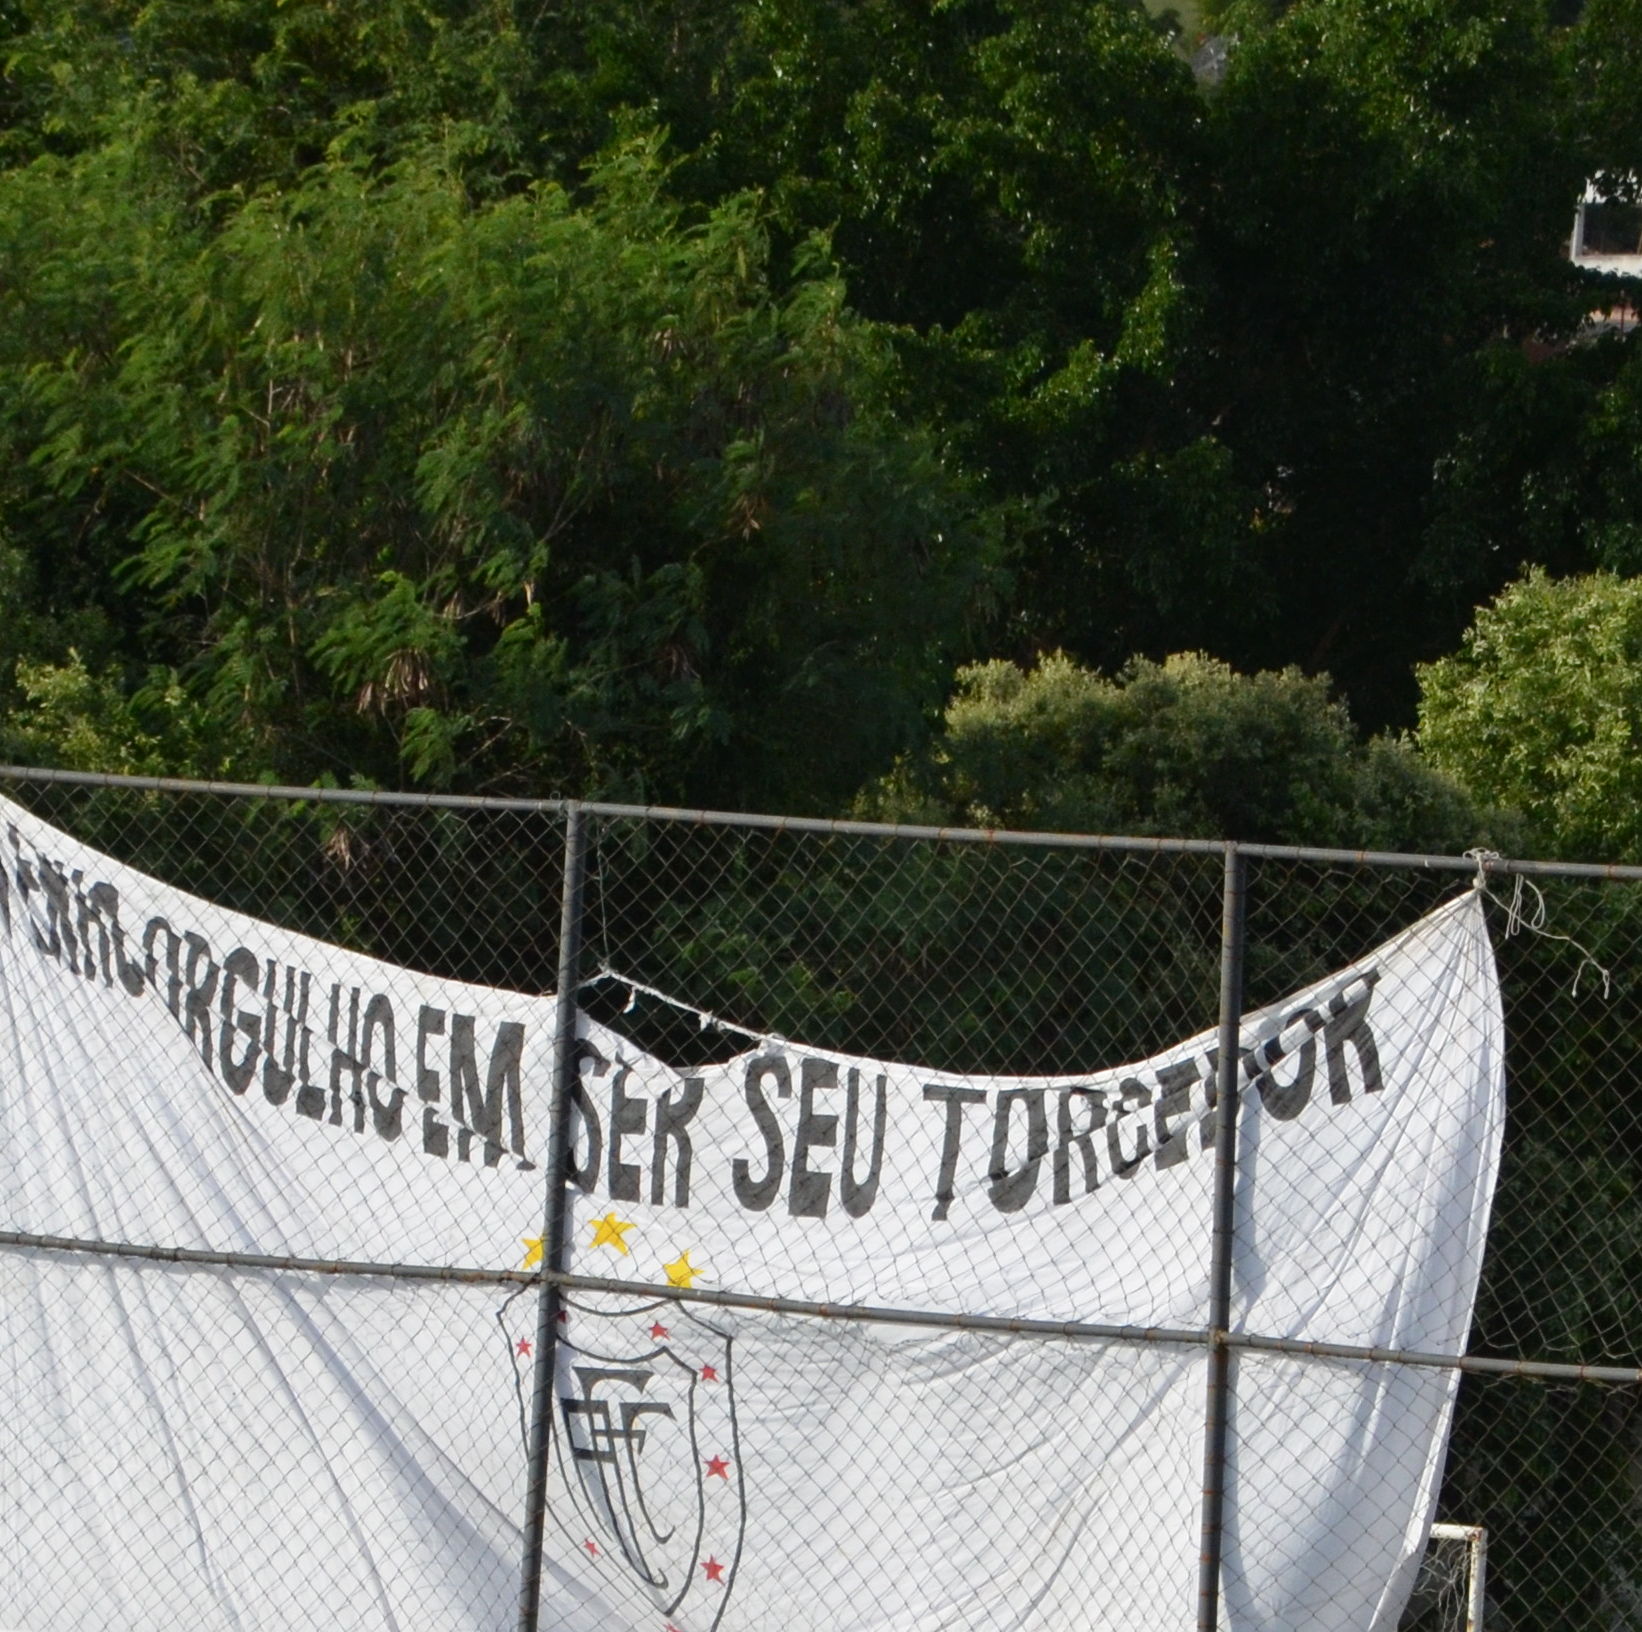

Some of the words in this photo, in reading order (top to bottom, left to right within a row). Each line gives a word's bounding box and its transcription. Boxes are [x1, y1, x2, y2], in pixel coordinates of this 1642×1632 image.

[143, 915, 404, 1143] ORGULHO
[416, 1004, 536, 1172] EM
[561, 1037, 705, 1208] SER
[731, 1055, 888, 1219] SEU
